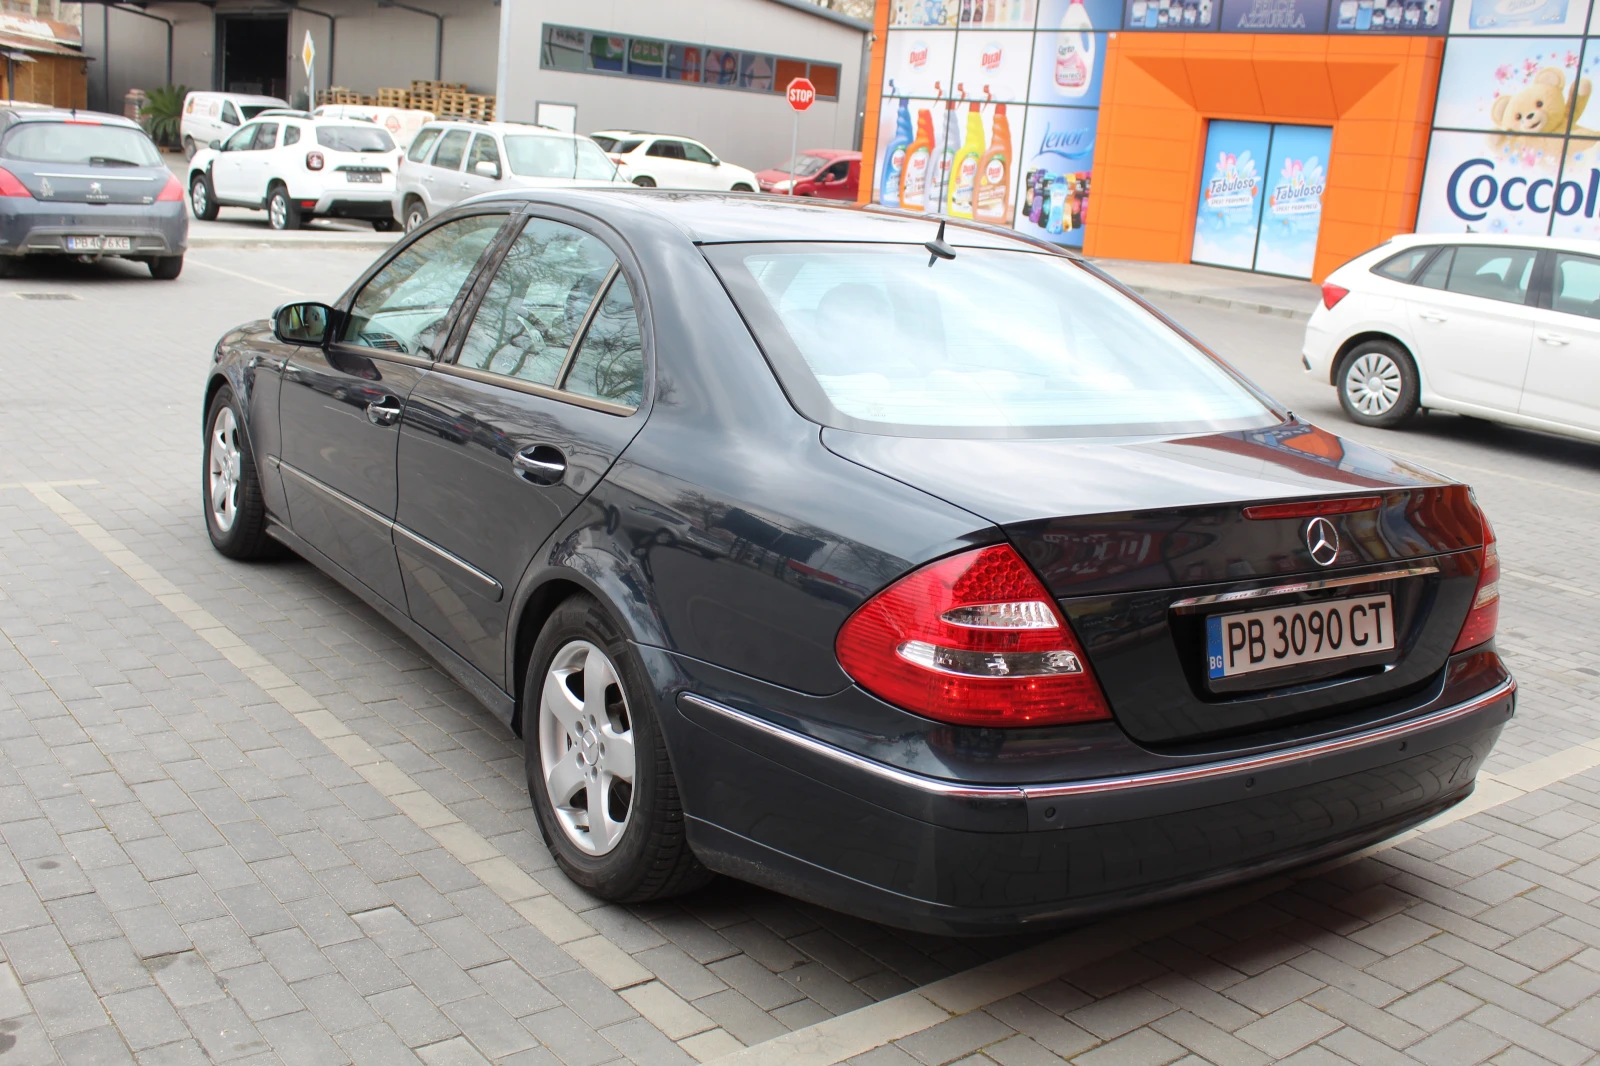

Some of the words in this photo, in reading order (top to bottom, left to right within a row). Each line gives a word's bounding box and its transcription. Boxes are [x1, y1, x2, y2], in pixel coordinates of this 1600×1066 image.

[1237, 13, 1306, 28] AZZURRA
[909, 48, 928, 64] Dual
[981, 49, 1002, 67] Dual
[790, 88, 813, 102] STOP
[1037, 121, 1085, 155] Lenor
[1211, 178, 1255, 194] Fabuloso
[1275, 185, 1323, 201] Fabuloso
[90, 237, 114, 249] 406
[1227, 618, 1266, 668] PB
[1273, 608, 1343, 659] 3090
[1350, 601, 1386, 647] CT
[1209, 655, 1223, 670] BG
